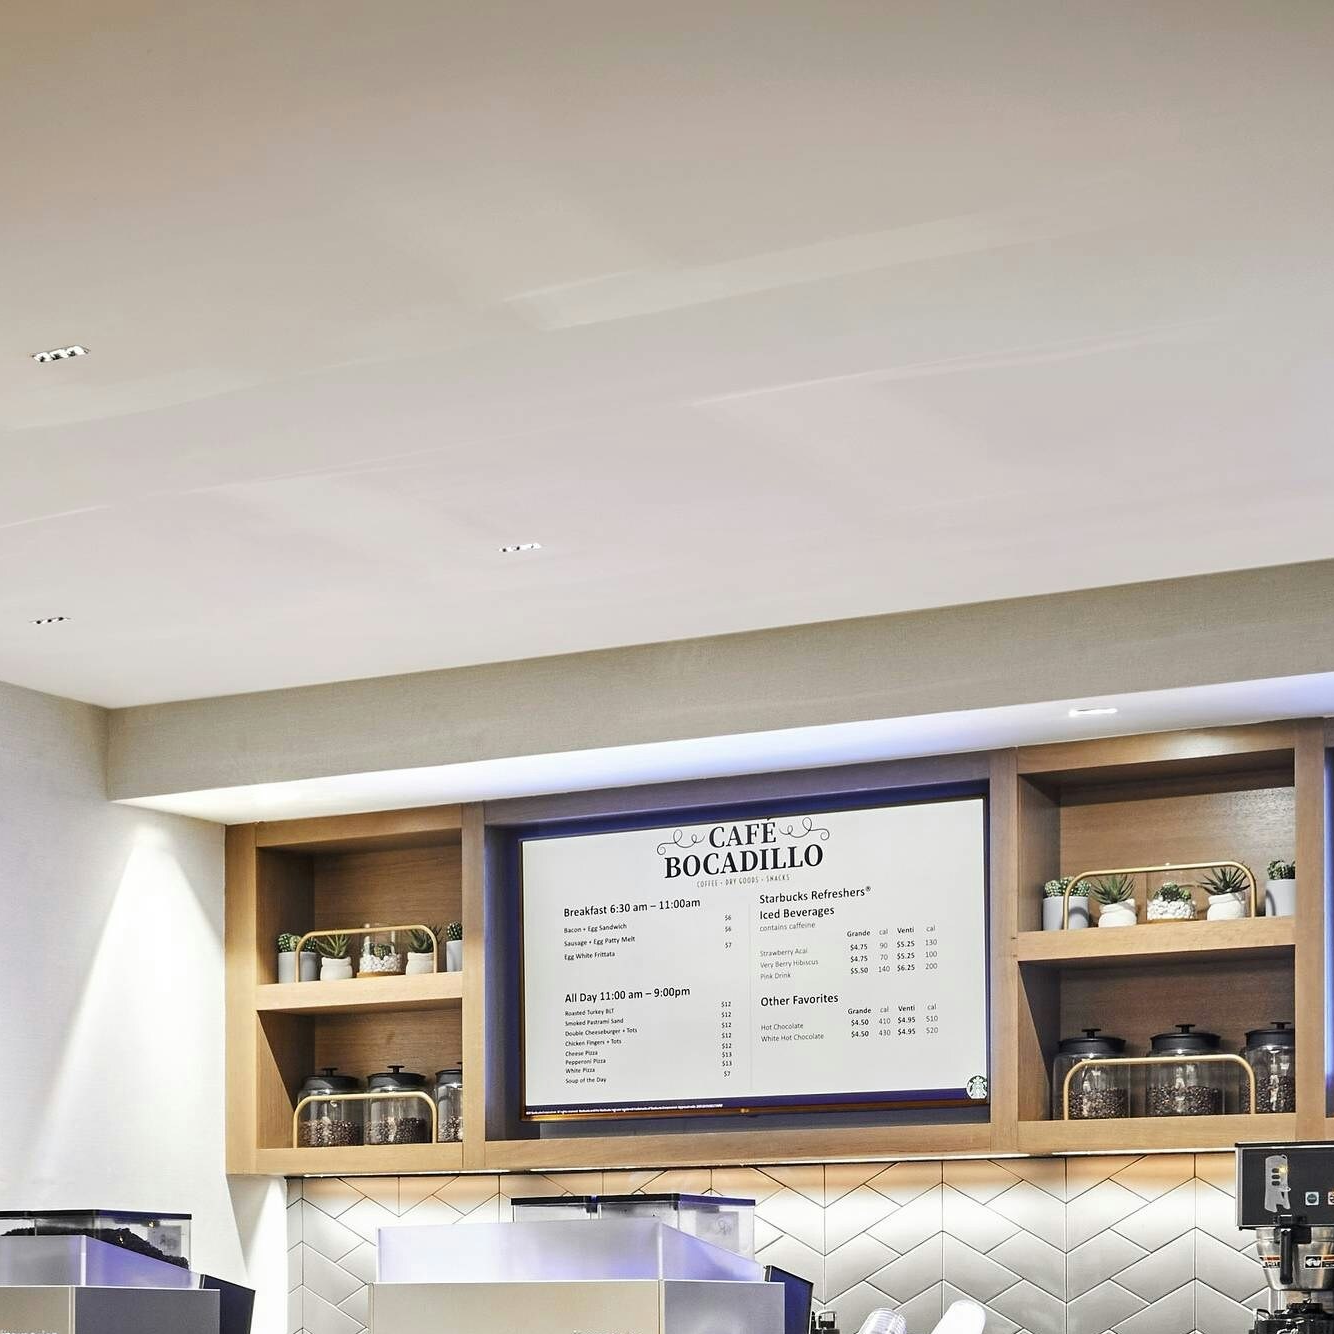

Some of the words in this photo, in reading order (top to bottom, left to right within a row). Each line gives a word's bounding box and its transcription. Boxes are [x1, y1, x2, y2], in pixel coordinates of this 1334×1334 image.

[664, 843, 823, 879] BOCADILLO
[759, 891, 808, 904] Starbucks
[564, 905, 607, 918] Breakfast
[610, 903, 631, 914] 6:30
[632, 904, 648, 912] am
[659, 898, 701, 910] 11:00am
[760, 909, 780, 920] Iced
[783, 907, 835, 918] Beverages
[759, 924, 788, 932] contains
[788, 921, 816, 930] caffeine
[846, 930, 871, 938] Grande
[878, 928, 889, 936] cal
[925, 924, 936, 932] cal
[564, 993, 577, 1003] All
[579, 992, 598, 1004] Day
[600, 990, 626, 1001] 11:00
[628, 991, 643, 1000] am
[653, 987, 691, 999] 9:00pm
[760, 996, 790, 1007] Other
[793, 993, 839, 1005] Favorites
[851, 1018, 870, 1027] $4.50
[878, 1017, 891, 1025] 410
[897, 1016, 916, 1024] $4.95
[925, 1015, 939, 1023] 510
